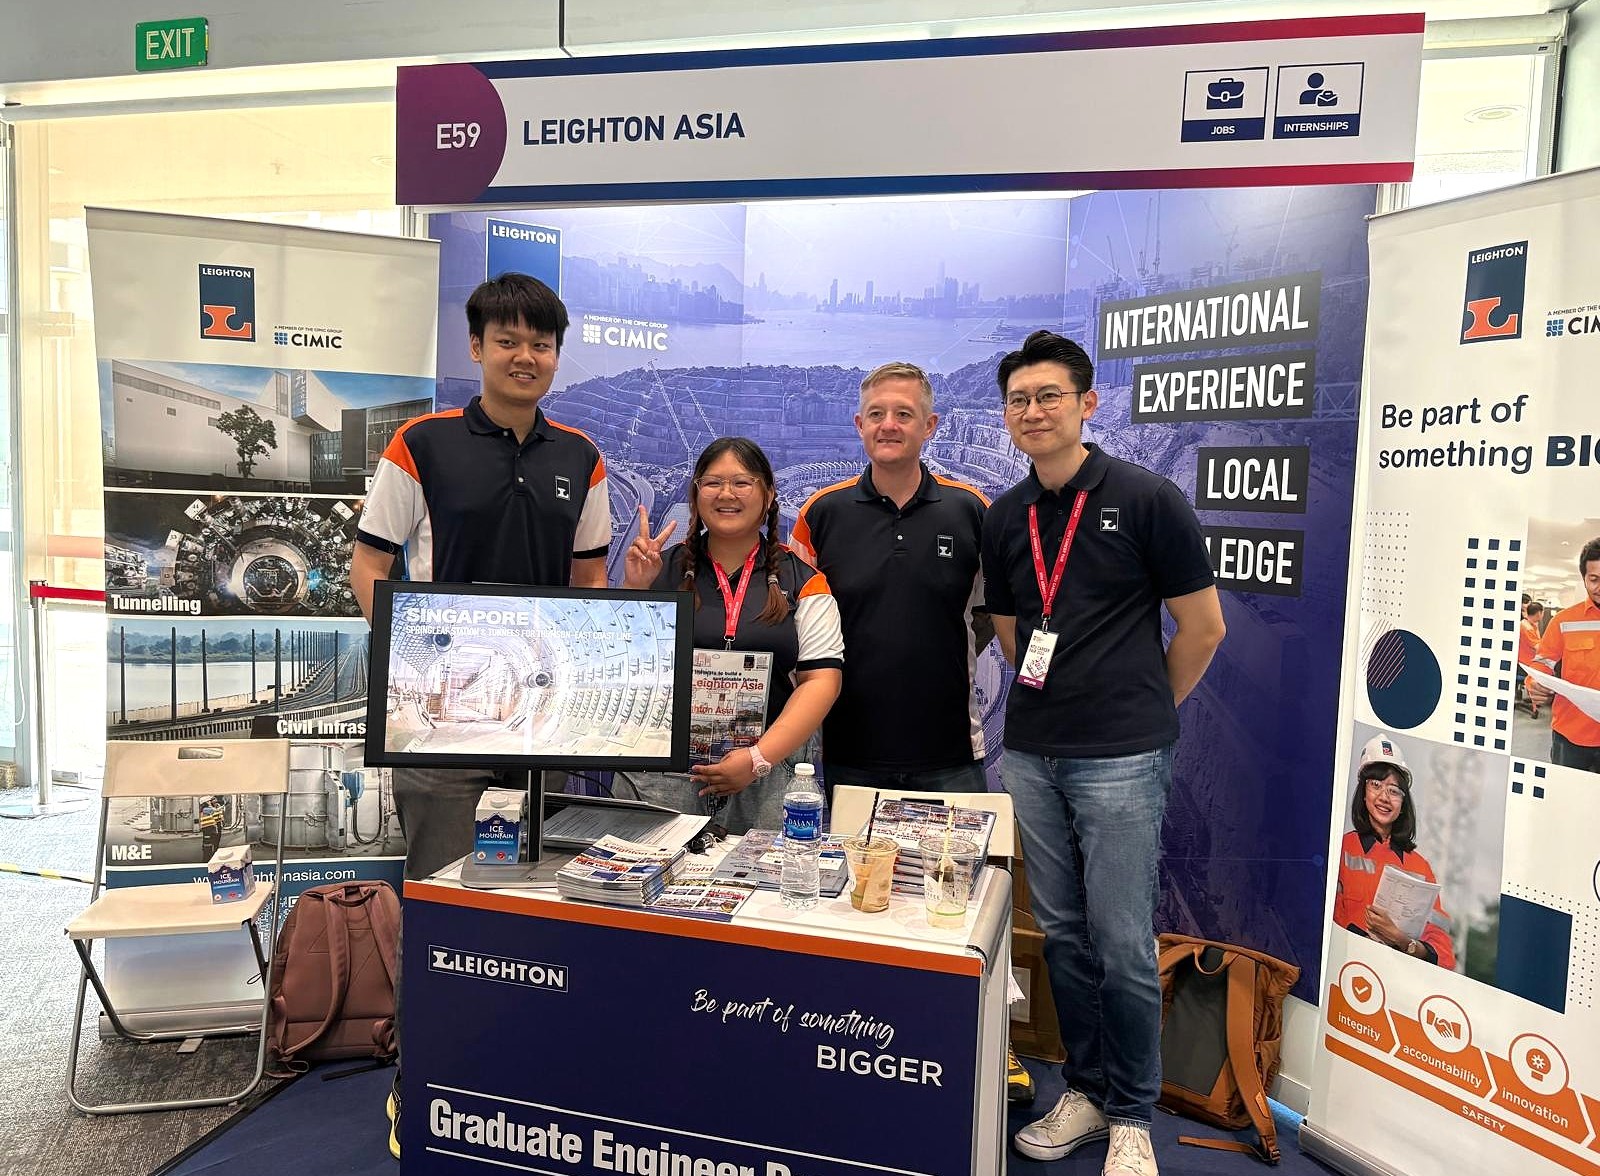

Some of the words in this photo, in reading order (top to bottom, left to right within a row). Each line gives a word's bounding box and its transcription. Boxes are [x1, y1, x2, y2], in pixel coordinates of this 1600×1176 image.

[146, 28, 195, 60] EXIT
[436, 122, 481, 150] E59
[522, 115, 665, 146] LEIGHTON
[672, 112, 745, 141] ASIA
[1210, 125, 1236, 135] JOBS
[1283, 121, 1349, 133] INTERNSHIPS
[492, 224, 557, 245] LEIGHTON
[1471, 246, 1524, 264] LEIGHTON
[202, 267, 251, 278] LEIGHTON
[588, 315, 612, 323] MEMBER
[633, 319, 649, 327] CIMIC
[649, 321, 668, 329] GROUP
[1104, 285, 1309, 350] INTERNATIONAL
[1553, 308, 1577, 316] MEMBER
[291, 333, 342, 349] CIMIC
[604, 326, 668, 351] CIMIC
[1138, 361, 1306, 414] EXPERIENCE
[1381, 404, 1413, 429] Be
[1421, 397, 1481, 434] part
[1490, 394, 1529, 423] of
[1379, 439, 1533, 475] something
[1545, 435, 1600, 467] BI
[1206, 458, 1298, 502] LOCAL
[110, 593, 202, 616] Tunnelling
[406, 607, 529, 626] SINGAPORE
[406, 625, 450, 635] SPRINGLEAF
[451, 627, 480, 637] STATION
[522, 630, 537, 638] FOR
[593, 631, 615, 640] COAST
[617, 632, 633, 641] LINE
[693, 680, 738, 690] eighton
[740, 680, 764, 690] Asia
[276, 718, 313, 735] Civil
[317, 718, 367, 735] Infras
[489, 825, 504, 833] ICE
[111, 844, 152, 861] M&E
[455, 954, 564, 988] LEIGHTON
[691, 989, 719, 1013] Be
[722, 997, 774, 1024] part
[772, 1004, 795, 1033] of
[799, 1009, 895, 1050] something
[1338, 1011, 1381, 1042] integrity
[816, 1044, 943, 1087] BIGGER
[1402, 1044, 1483, 1088] accountability
[1462, 1105, 1506, 1132] SAFETY
[1502, 1087, 1569, 1129] innovation
[429, 1098, 583, 1164] Graduate
